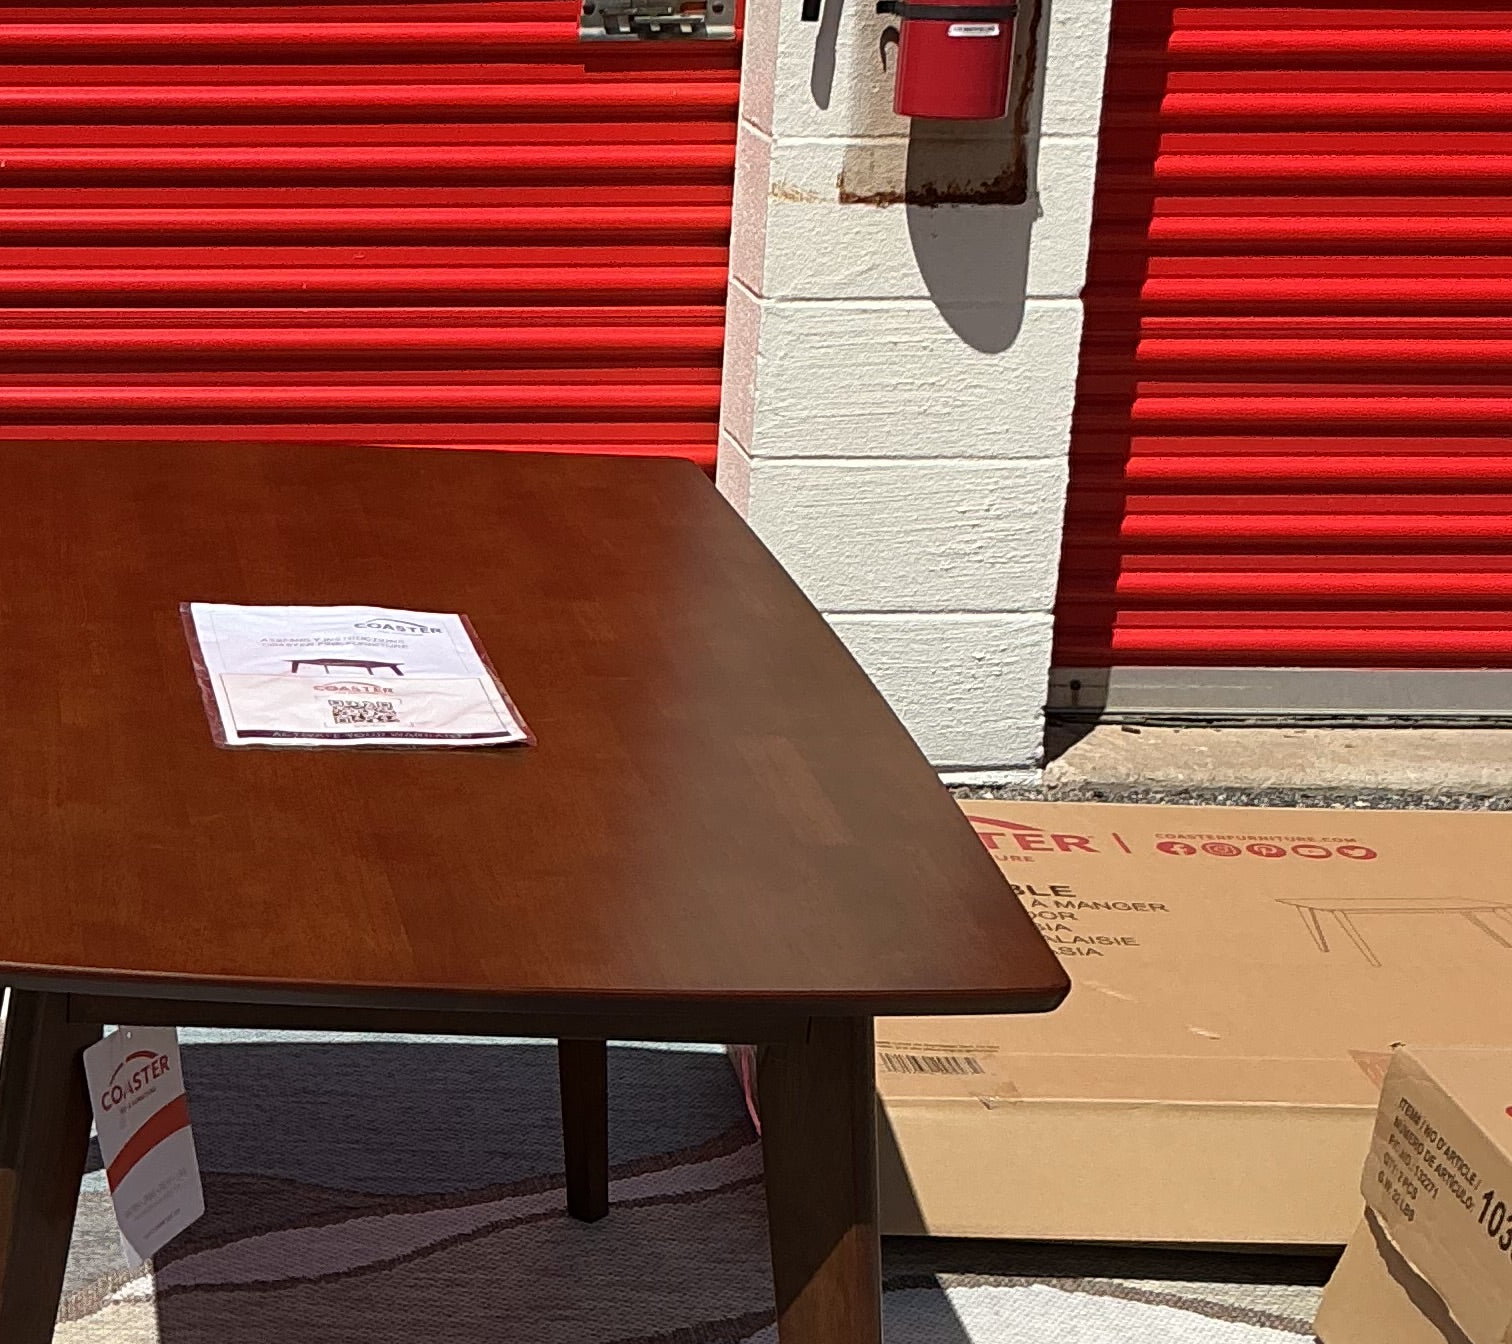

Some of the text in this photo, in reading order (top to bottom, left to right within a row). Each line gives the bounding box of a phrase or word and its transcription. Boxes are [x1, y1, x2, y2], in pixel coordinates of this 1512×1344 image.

[354, 621, 443, 635] COASTER
[313, 685, 394, 694] COASTER
[1054, 947, 1105, 957] SIA
[101, 1054, 170, 1112] COASTER
[1424, 1149, 1437, 1168] DE
[1478, 1189, 1512, 1265] 103
